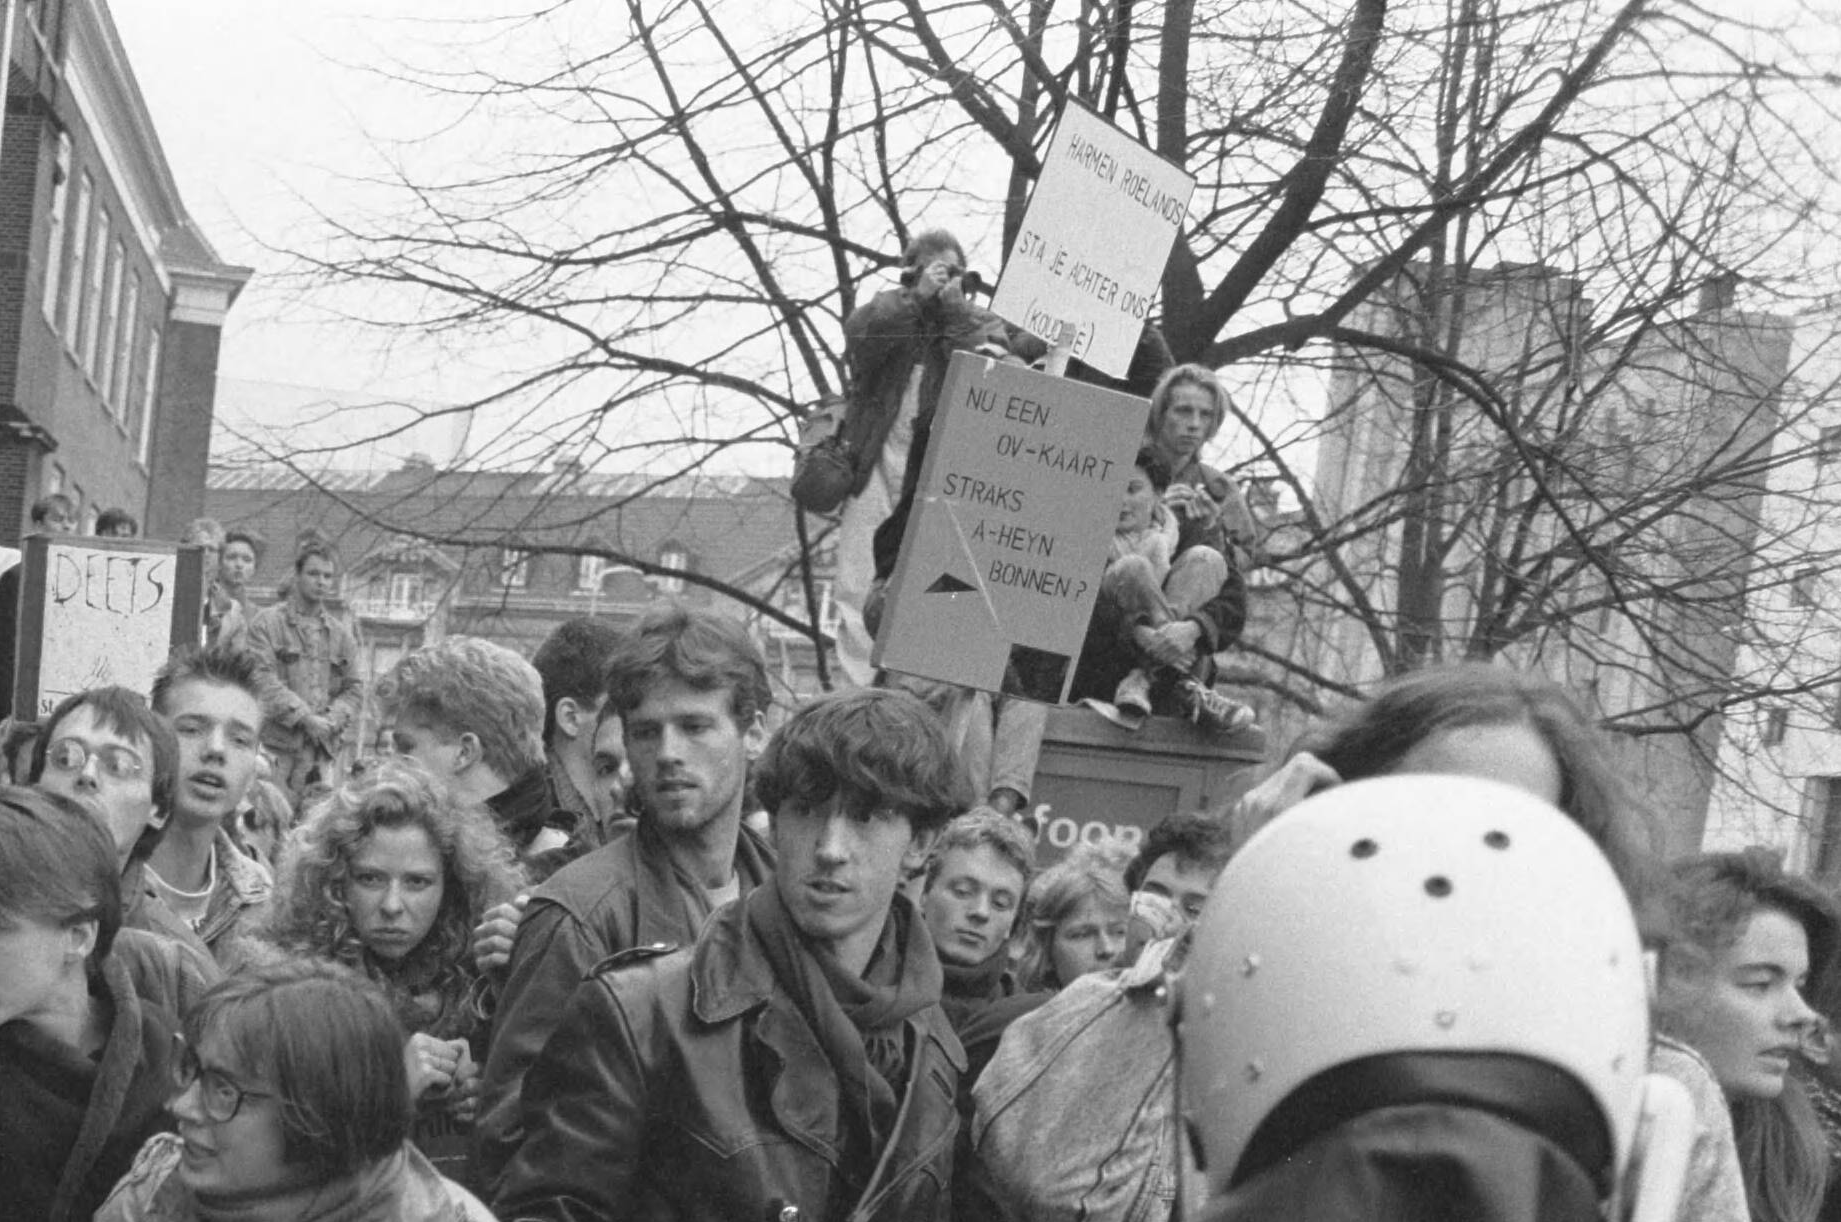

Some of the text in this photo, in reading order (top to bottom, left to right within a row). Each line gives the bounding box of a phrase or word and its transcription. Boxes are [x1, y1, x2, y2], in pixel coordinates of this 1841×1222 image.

[1068, 132, 1184, 227] HARMEN ROELANDS
[1019, 230, 1044, 265] STA
[1049, 244, 1068, 276] JE
[1069, 263, 1120, 306] ACHTER
[965, 386, 1051, 427] NU EEN
[996, 434, 1115, 481] OV-KAART
[942, 472, 1025, 513] STRAKS
[971, 519, 1055, 557] A-HEYN
